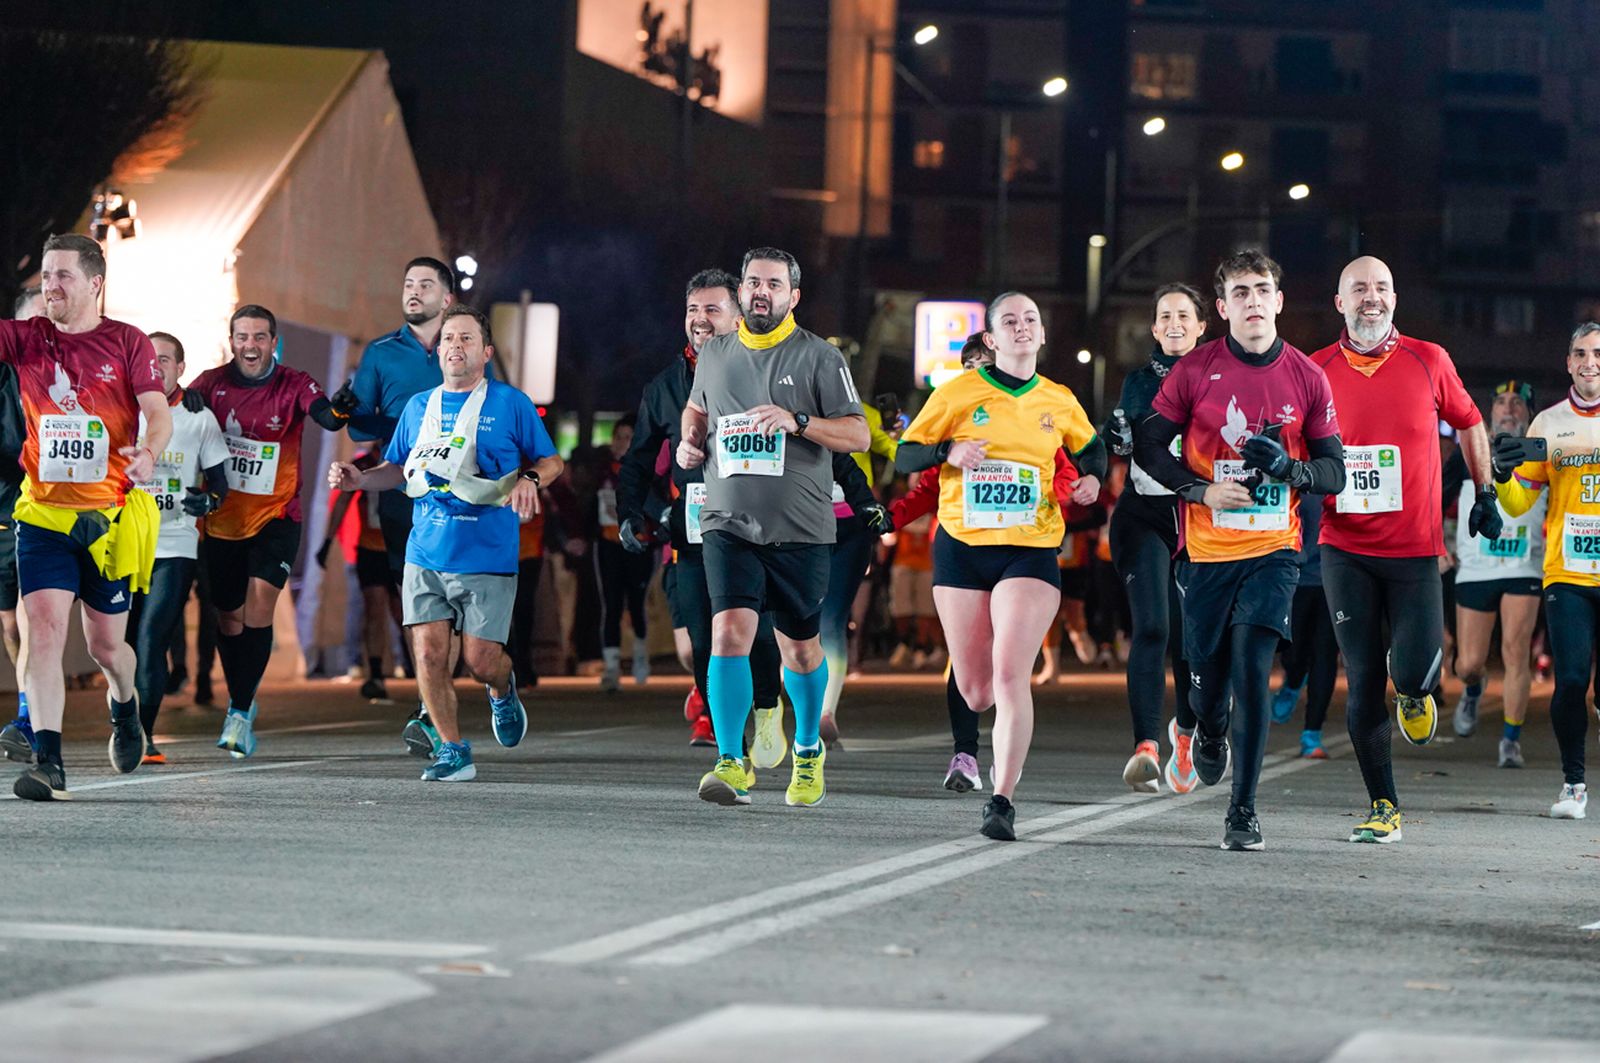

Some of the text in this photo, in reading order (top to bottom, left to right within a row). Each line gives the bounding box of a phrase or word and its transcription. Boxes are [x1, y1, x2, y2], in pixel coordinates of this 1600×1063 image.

[48, 440, 95, 460] 3498
[722, 433, 777, 453] 13068
[231, 456, 264, 476] 1617
[1351, 470, 1380, 490] 156
[972, 483, 1031, 505] 12328
[1573, 536, 1600, 554] 825
